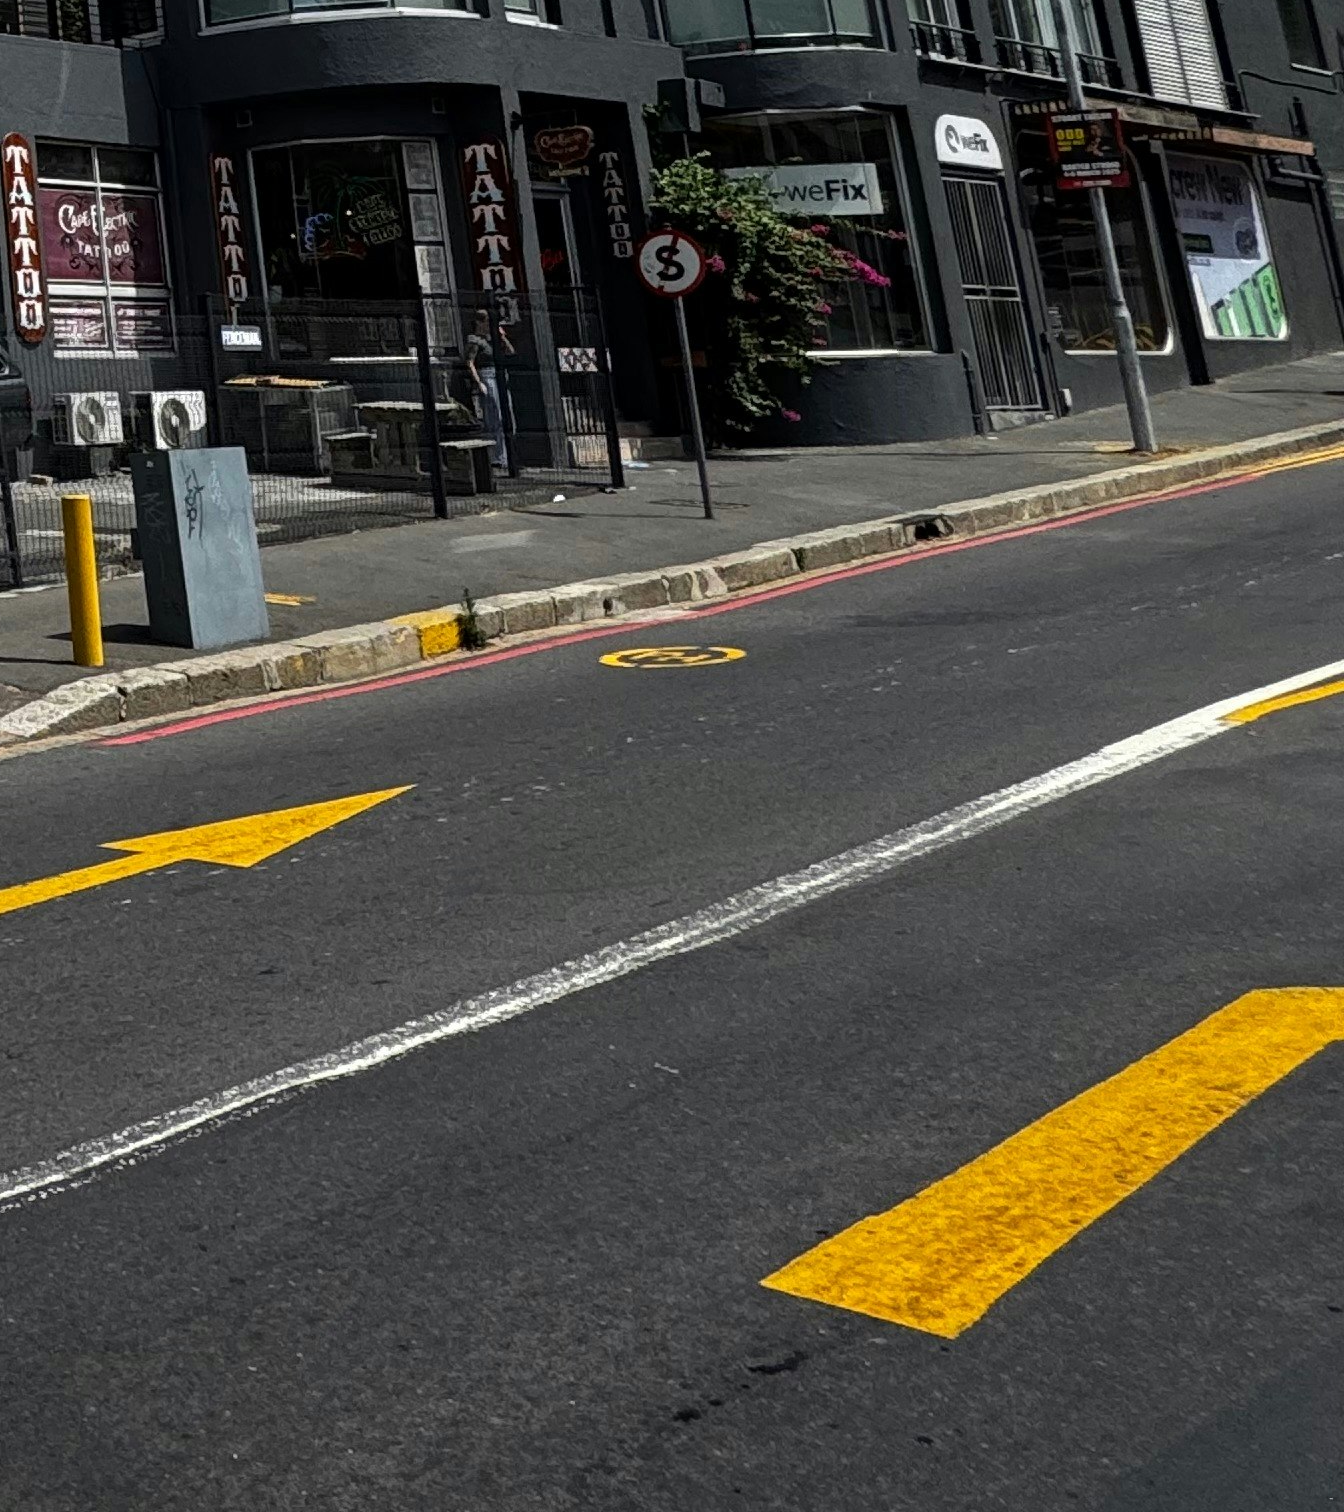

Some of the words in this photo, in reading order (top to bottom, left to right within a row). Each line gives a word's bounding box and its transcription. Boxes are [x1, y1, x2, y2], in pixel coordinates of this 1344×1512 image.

[5, 145, 45, 330] TATTOO
[214, 157, 249, 324] TATTO
[599, 151, 634, 258] TATTOO
[783, 178, 868, 202] weFix
[655, 245, 685, 281] S
